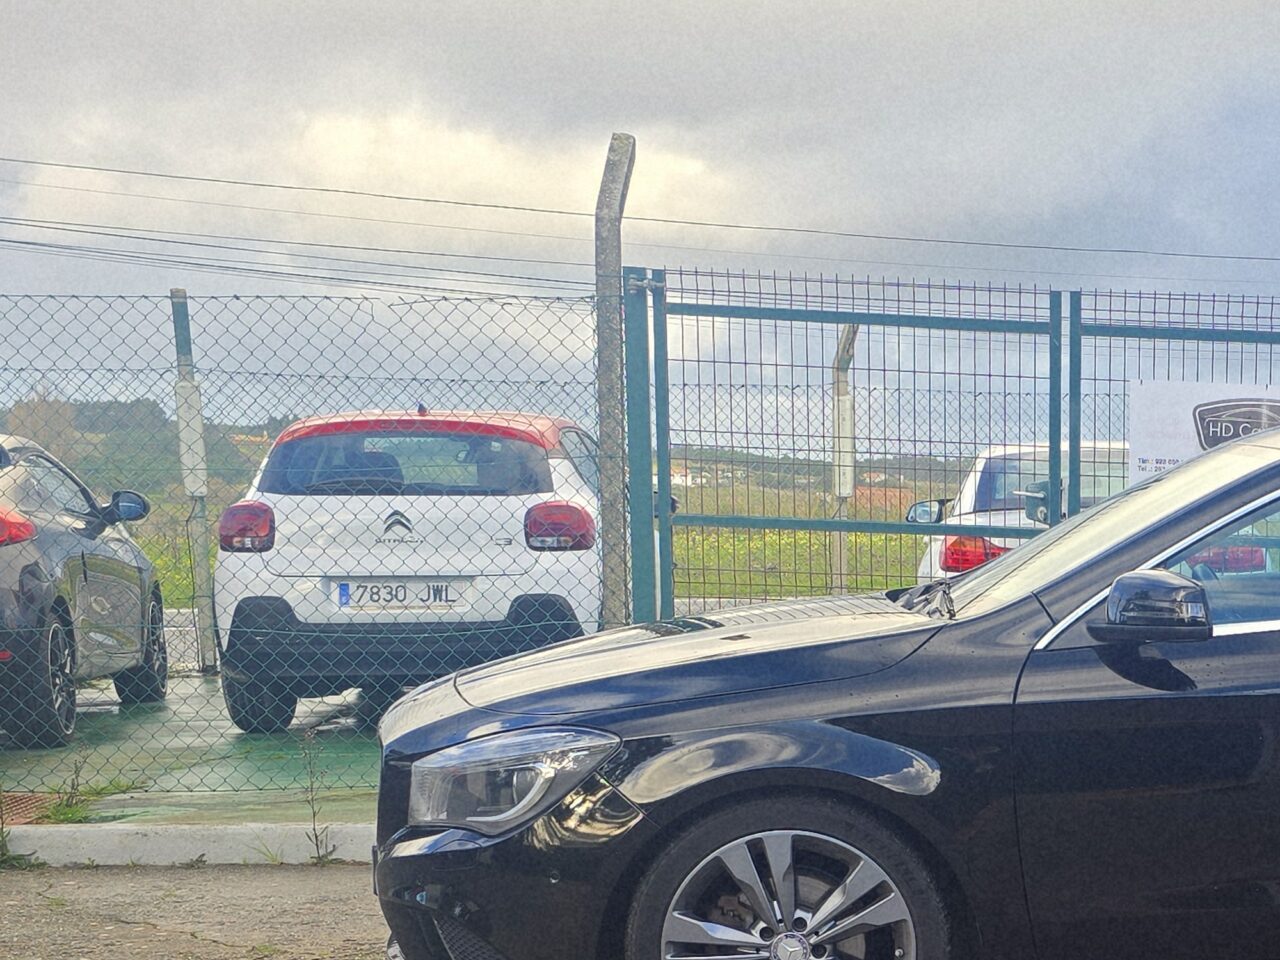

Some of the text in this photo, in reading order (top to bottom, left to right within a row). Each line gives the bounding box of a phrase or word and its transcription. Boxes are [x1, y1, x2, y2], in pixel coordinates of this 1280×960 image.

[1209, 422, 1234, 437] HD
[356, 585, 457, 603] 7830 JWL
